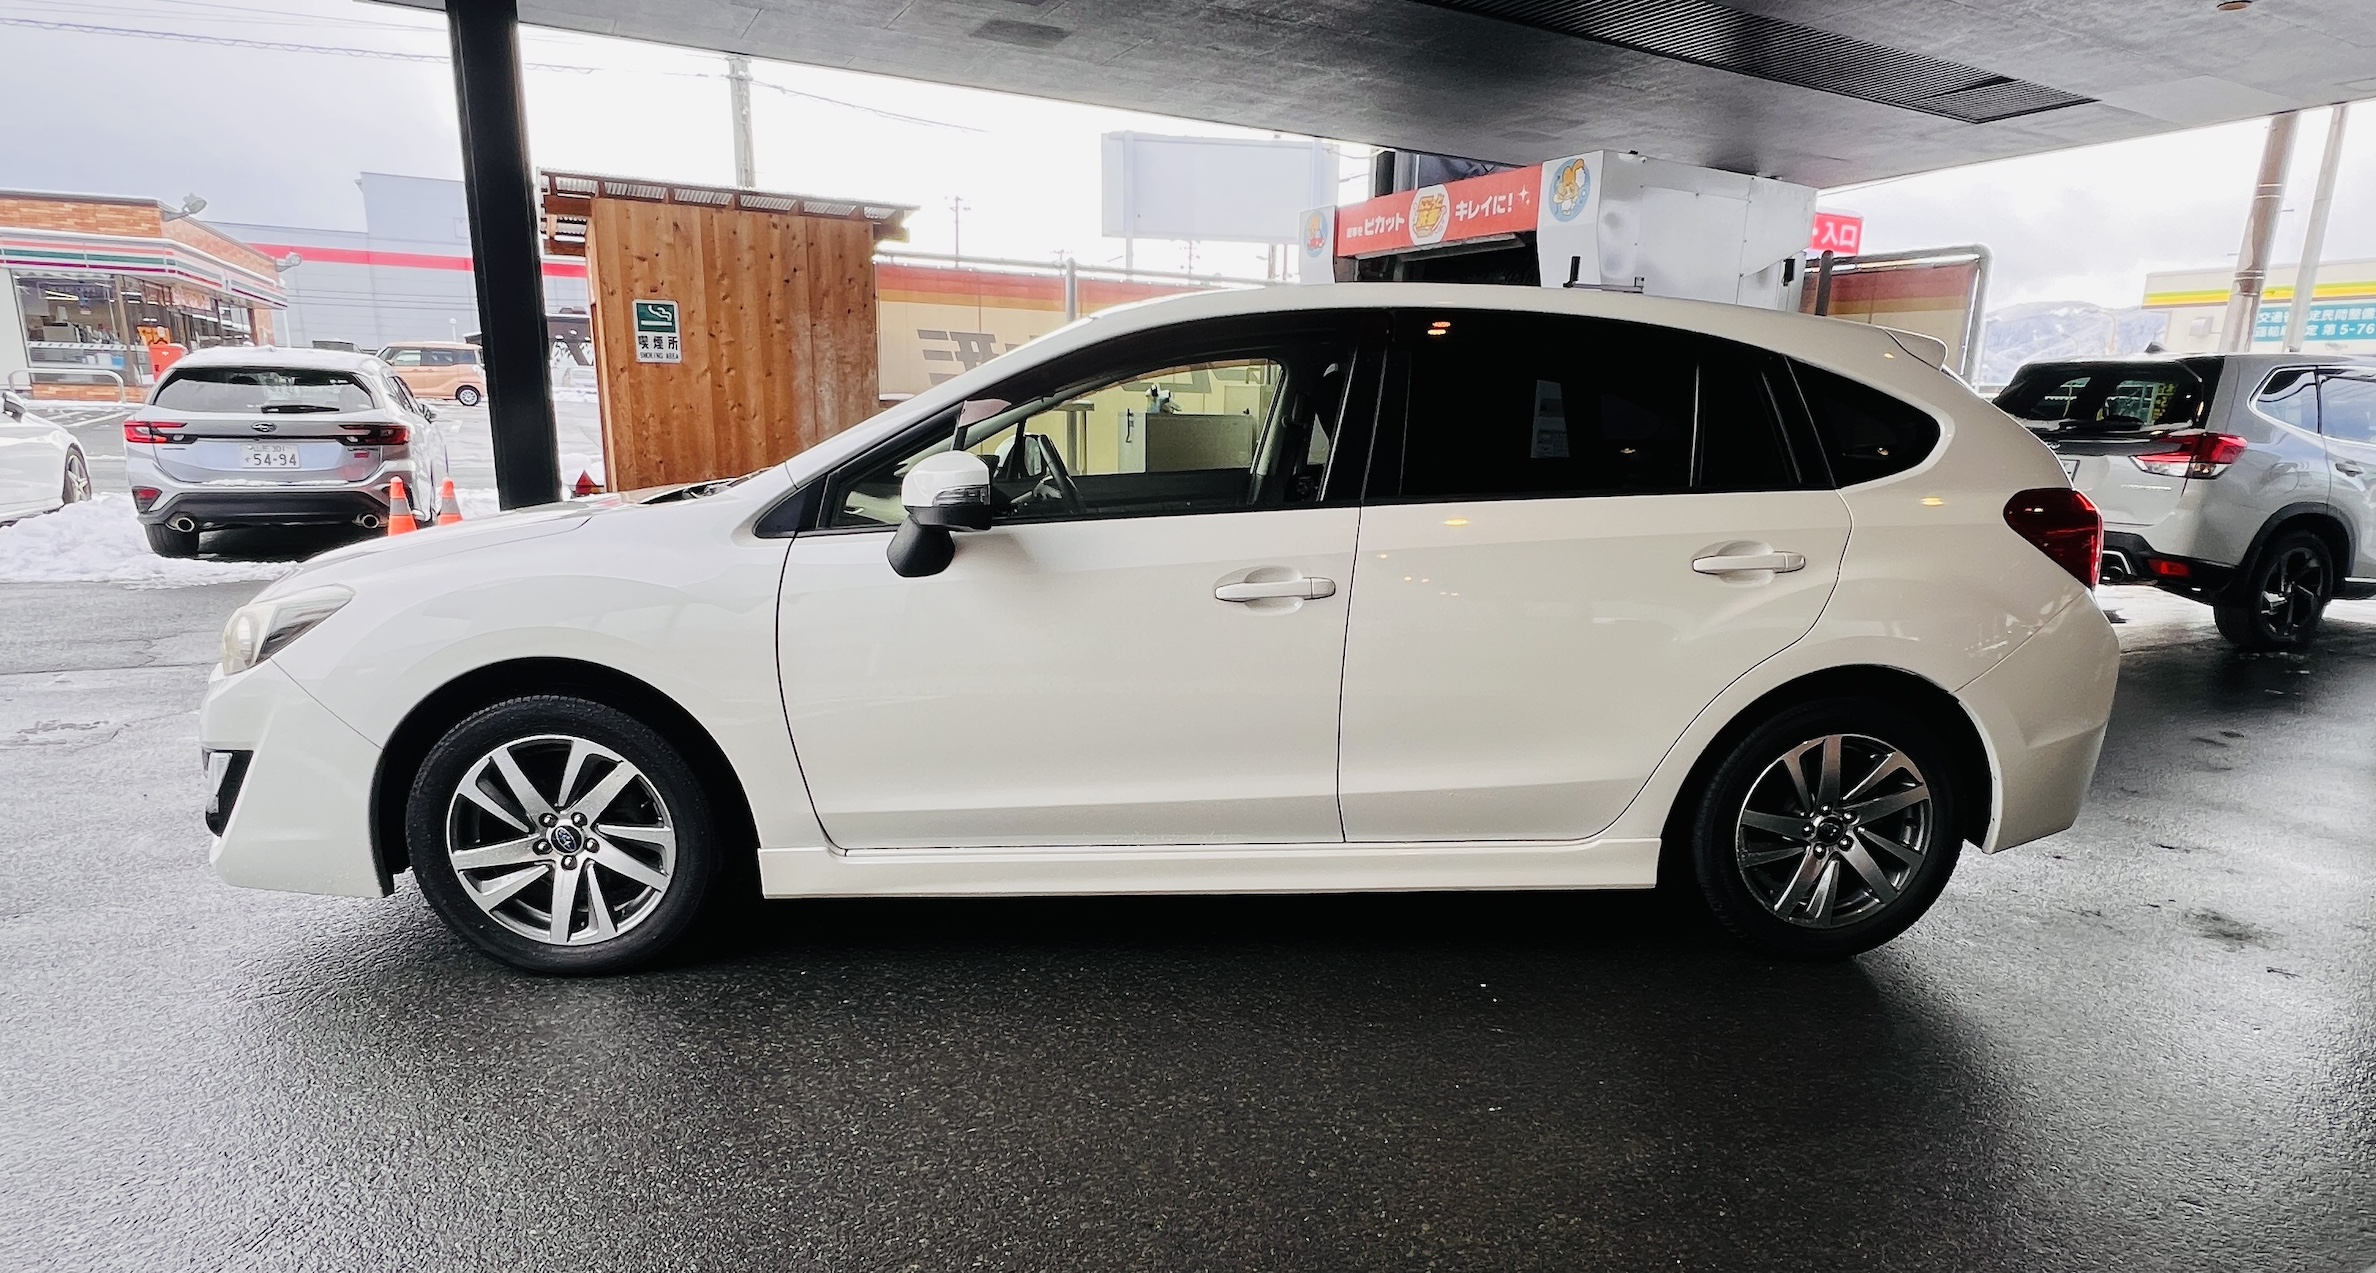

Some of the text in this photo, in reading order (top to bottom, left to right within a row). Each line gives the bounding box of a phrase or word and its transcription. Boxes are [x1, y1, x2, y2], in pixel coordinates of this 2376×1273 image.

[1455, 192, 1514, 222] キレイに!
[2257, 307, 2376, 323] 交通定民間整備
[2254, 324, 2319, 338] 運輸定
[2321, 323, 2337, 336] 第
[638, 335, 678, 350] 喫煙所
[253, 453, 297, 466] 54-94
